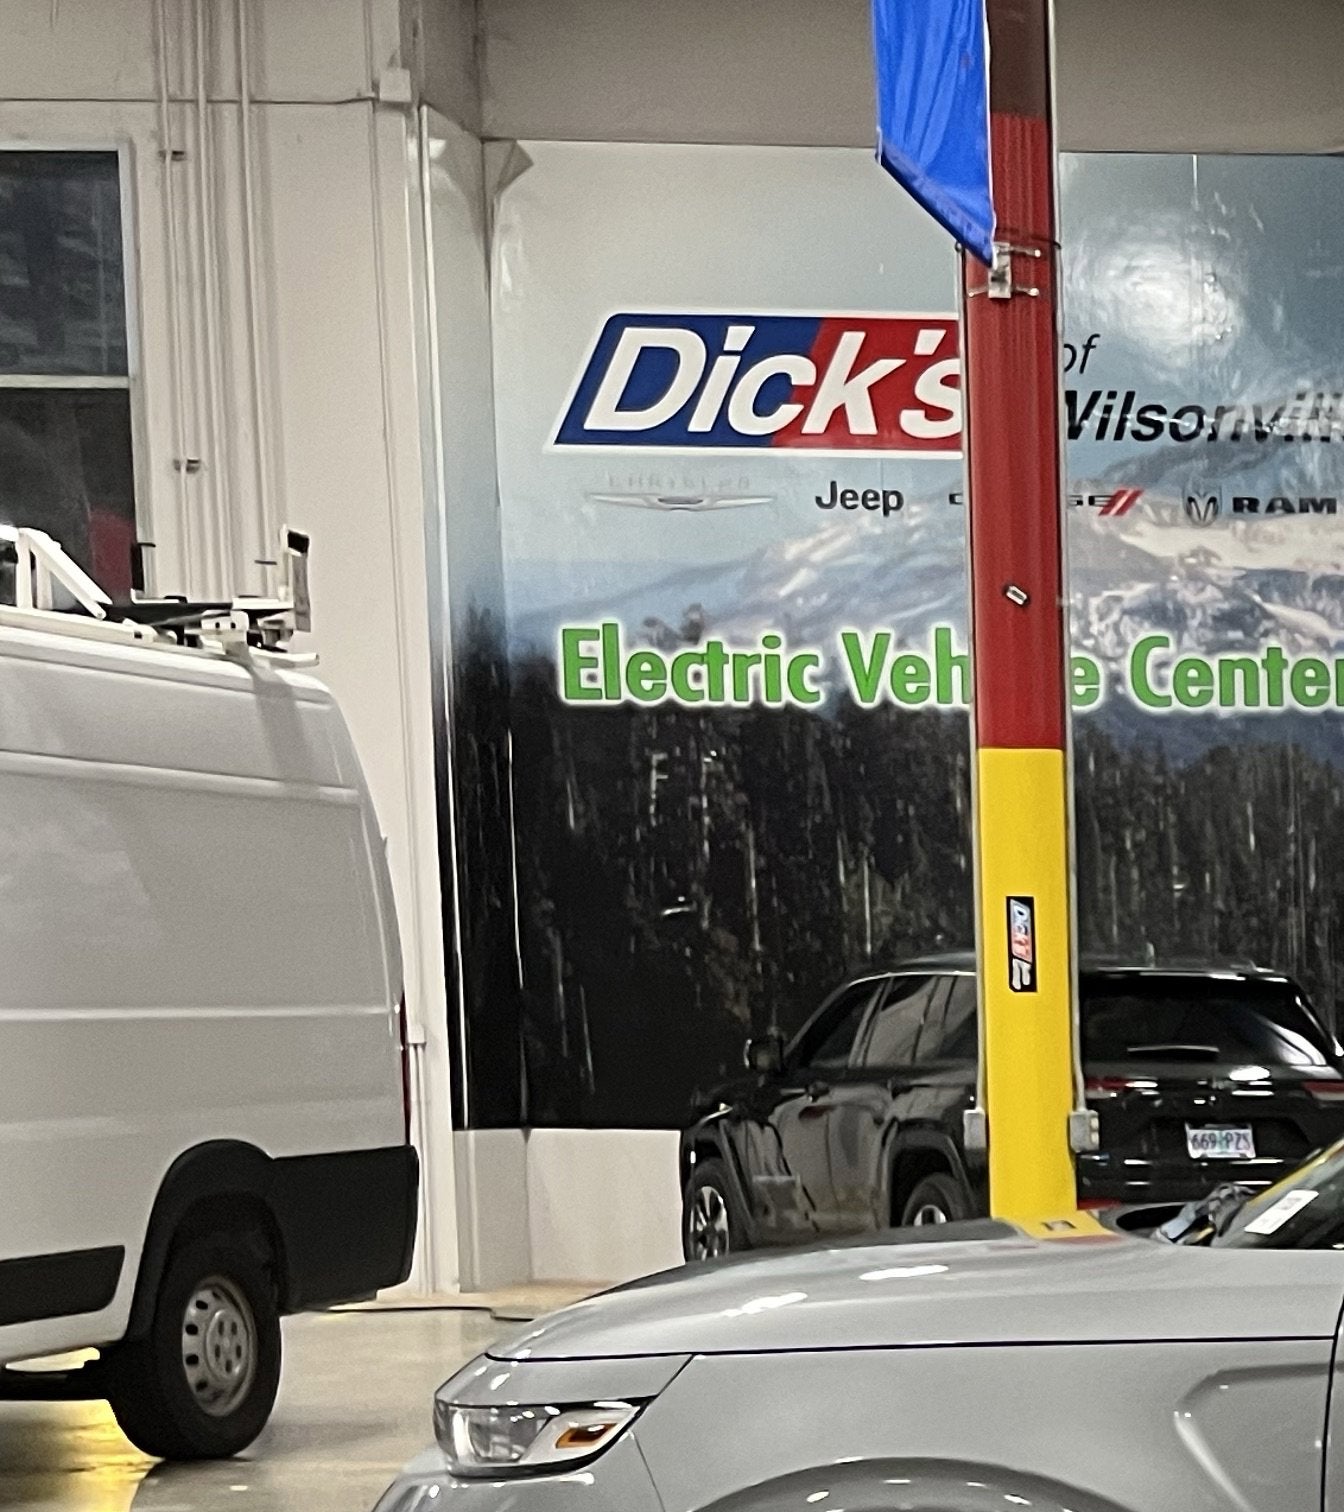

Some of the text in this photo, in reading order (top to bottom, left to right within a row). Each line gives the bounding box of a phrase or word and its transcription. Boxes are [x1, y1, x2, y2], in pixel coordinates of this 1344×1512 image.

[583, 326, 963, 439] Dick's
[814, 480, 905, 517] Jeep
[1231, 495, 1338, 515] RAM
[562, 622, 821, 703] Electric
[841, 627, 1100, 707] Vehe
